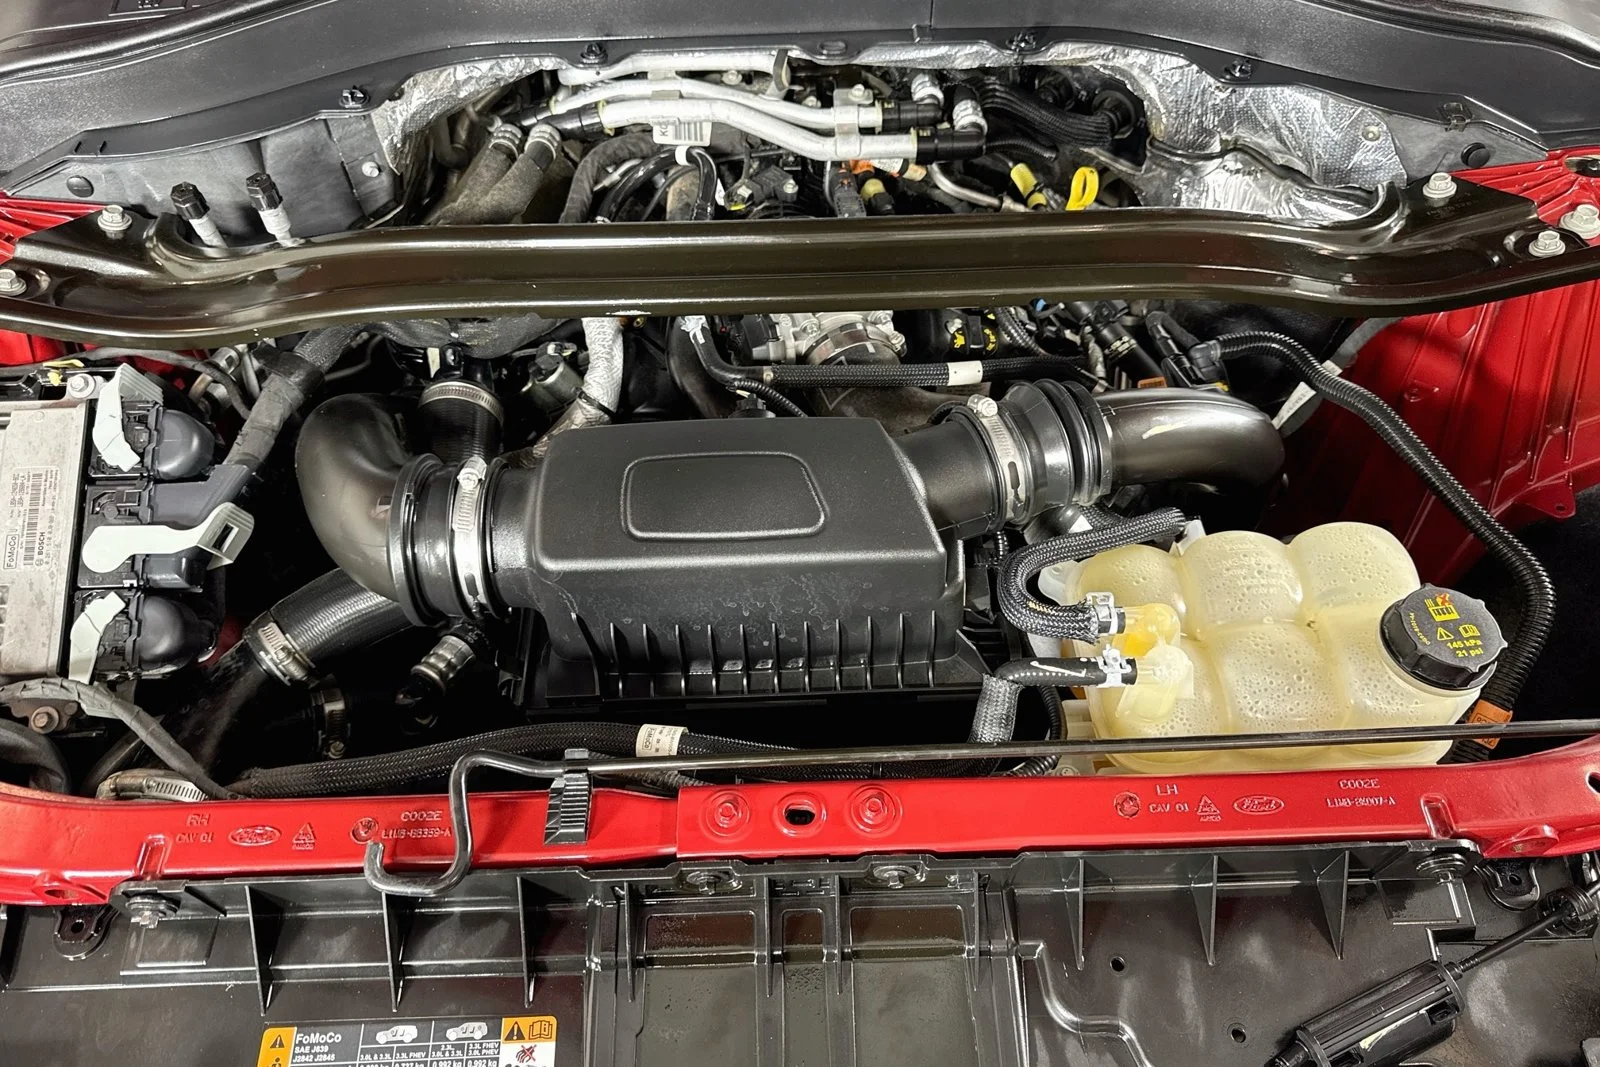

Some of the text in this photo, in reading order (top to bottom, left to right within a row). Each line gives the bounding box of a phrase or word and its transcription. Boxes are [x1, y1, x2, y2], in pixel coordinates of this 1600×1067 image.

[37, 531, 46, 556] BOSCH
[6, 536, 17, 568] FoMoCo
[1447, 639, 1483, 650] 145 kPa
[1455, 647, 1484, 658] 21 psi
[1155, 783, 1179, 796] LH
[1148, 802, 1170, 813] CAV
[1236, 795, 1281, 812] Ford
[185, 812, 211, 828] RH
[295, 1031, 342, 1045] FoMoCo
[294, 1044, 329, 1054] SAE J639
[481, 1048, 499, 1056] PHEV
[292, 1053, 336, 1063] J2842 J2845
[409, 1051, 426, 1059] FHEV
